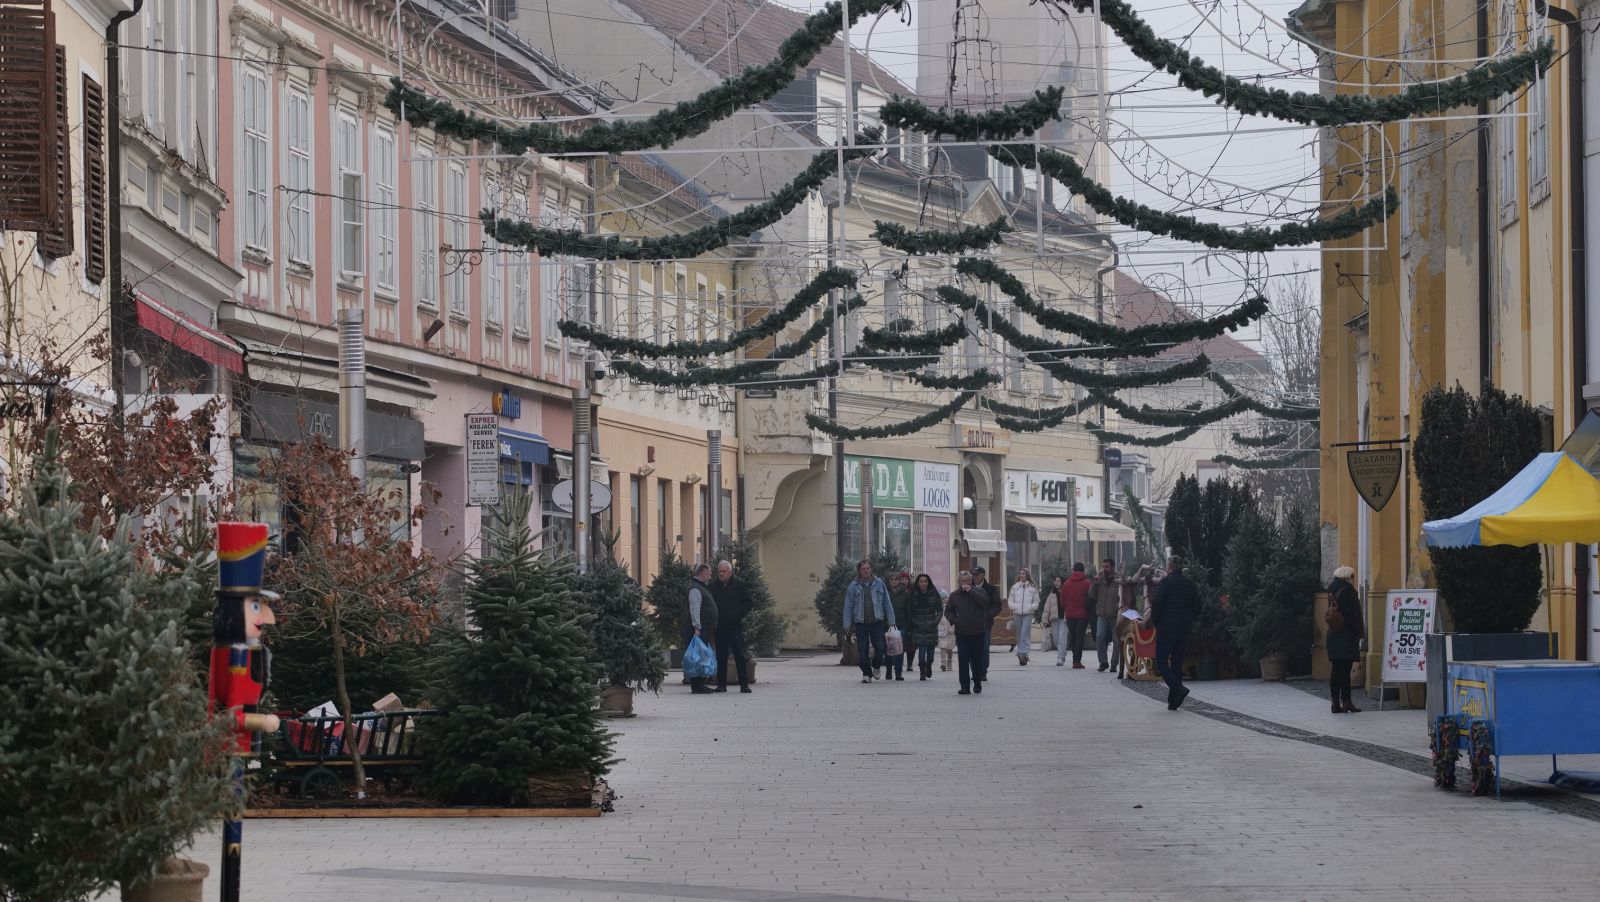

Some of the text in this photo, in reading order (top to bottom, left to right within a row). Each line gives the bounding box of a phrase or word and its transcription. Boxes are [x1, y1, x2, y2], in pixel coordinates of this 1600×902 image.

[470, 416, 495, 424] EXPRES
[1352, 454, 1397, 464] ZLATARNA
[1376, 466, 1397, 475] GOLD
[844, 460, 910, 500] MDA
[922, 487, 951, 509] LOGOS
[1395, 633, 1425, 647] -50%
[1397, 647, 1422, 655] NA SVE
